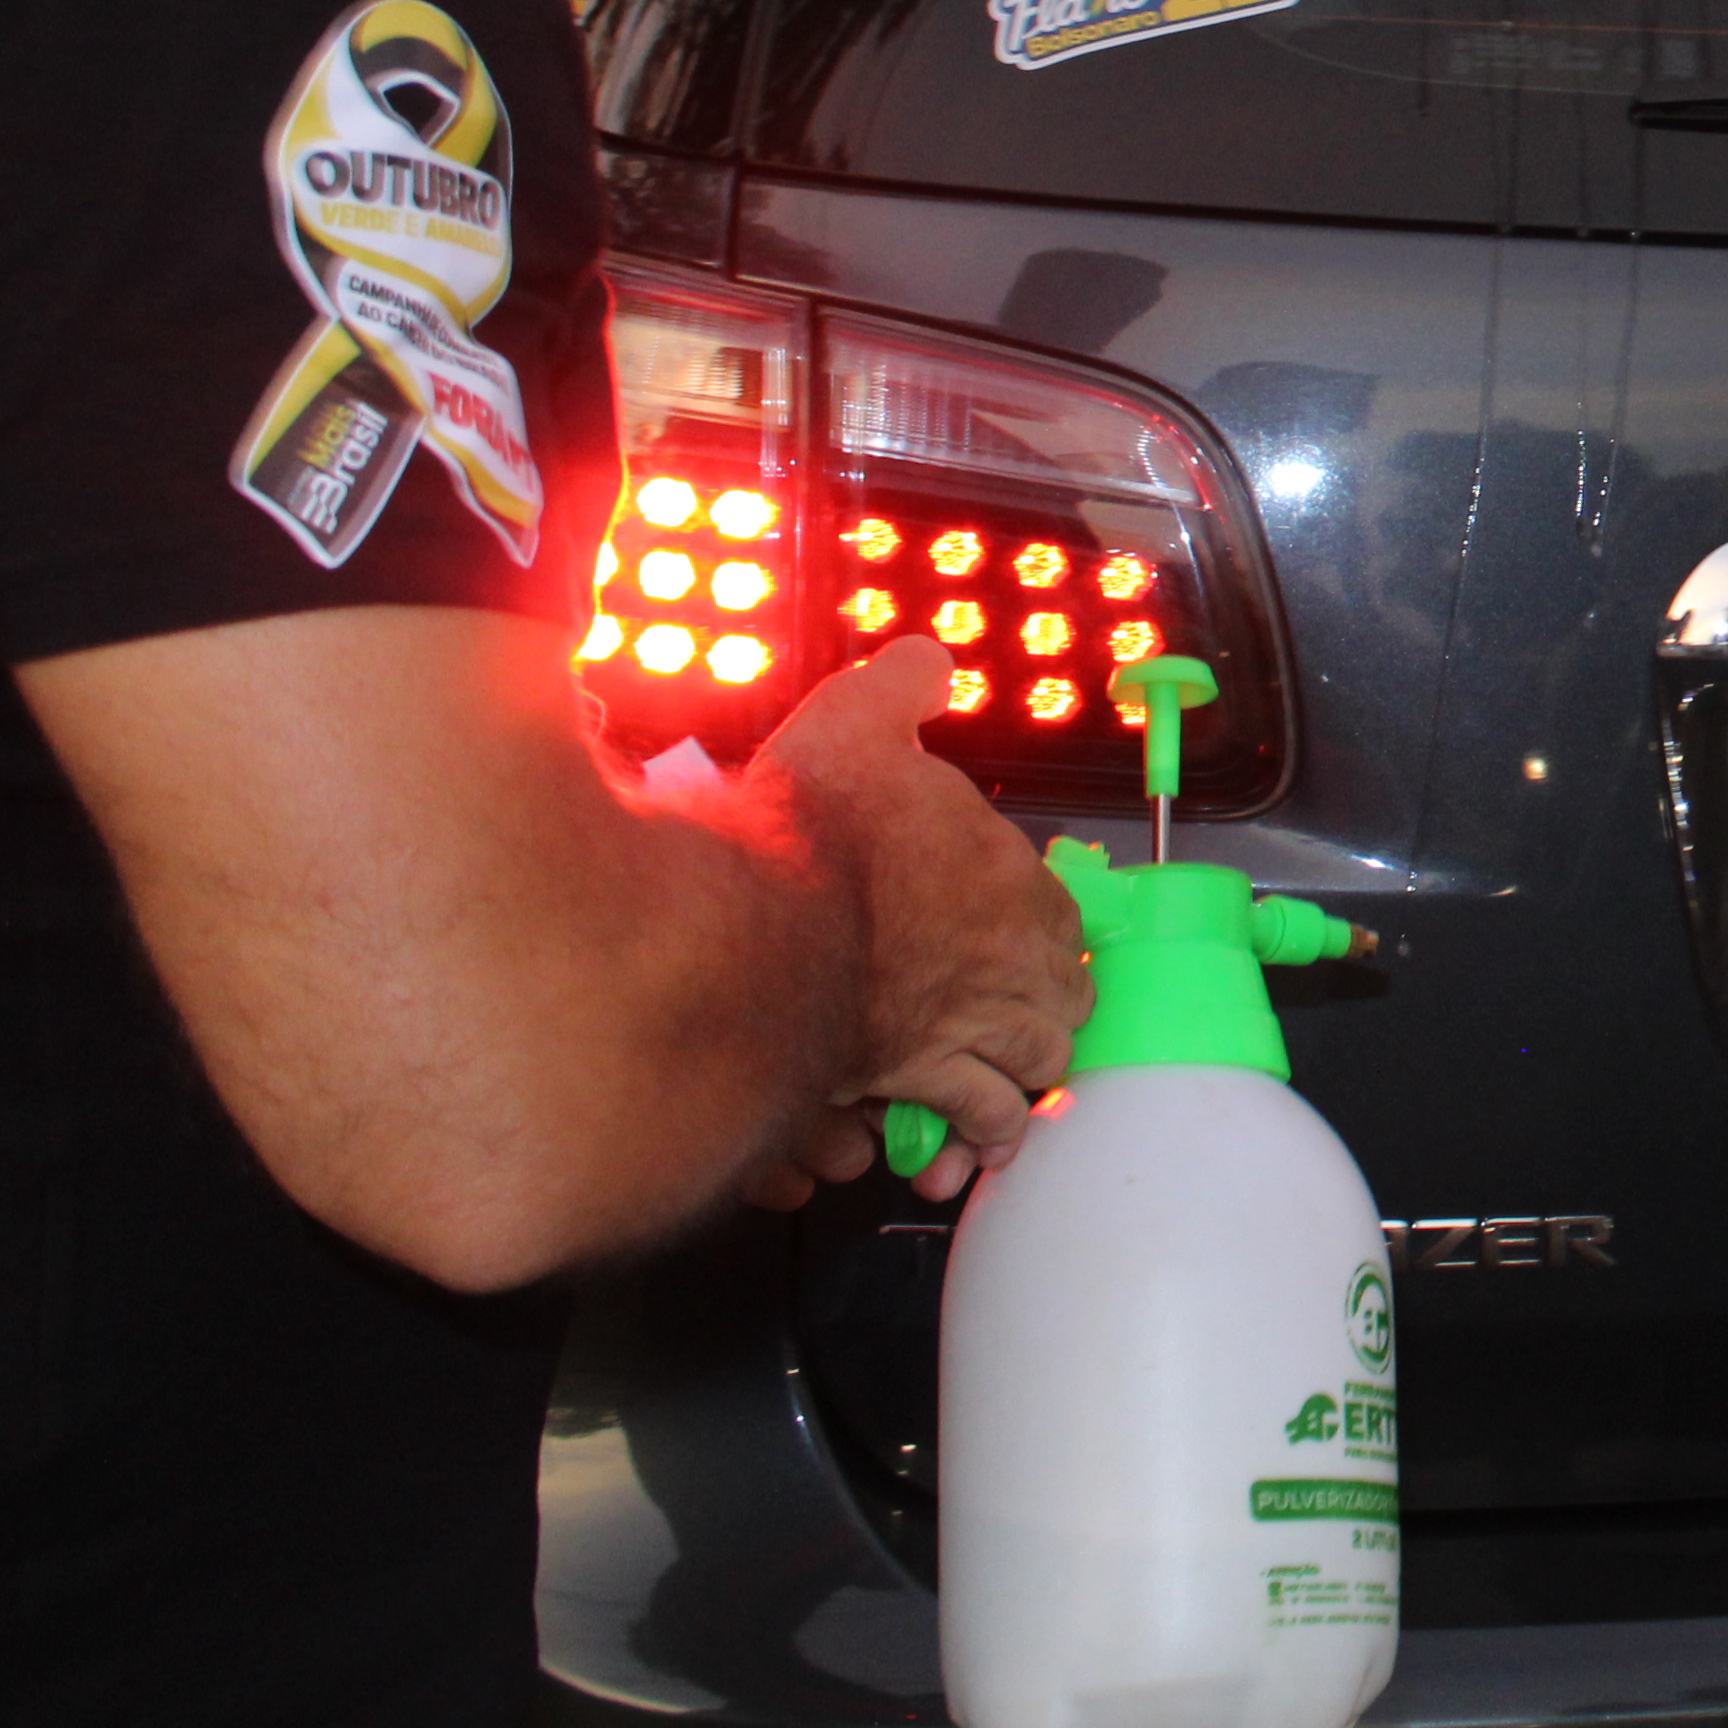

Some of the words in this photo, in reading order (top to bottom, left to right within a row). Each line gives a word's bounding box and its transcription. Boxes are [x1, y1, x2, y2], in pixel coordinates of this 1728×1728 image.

[306, 150, 501, 230] OUTUBRO
[320, 203, 400, 235] VERDE
[404, 214, 419, 237] E
[297, 403, 358, 469] Mais
[300, 399, 389, 535] Brasil
